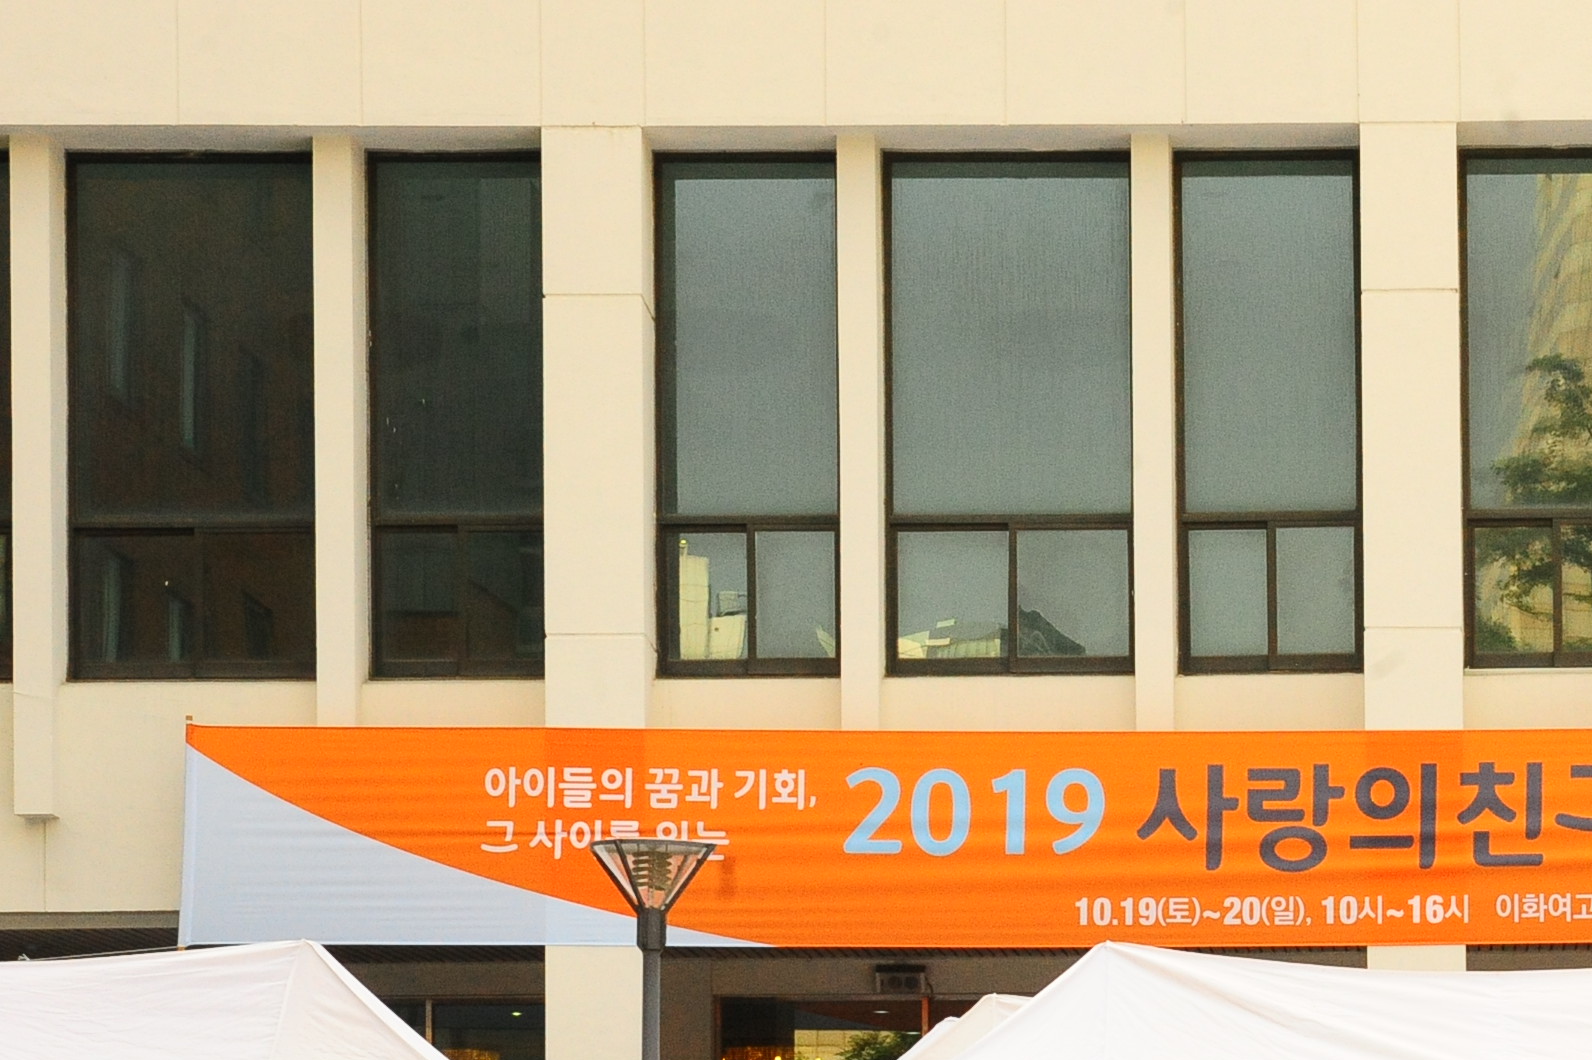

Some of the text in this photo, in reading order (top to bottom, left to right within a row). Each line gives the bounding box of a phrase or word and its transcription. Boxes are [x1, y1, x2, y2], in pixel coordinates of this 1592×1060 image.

[484, 766, 817, 811] 아이들의 꿈과 기회,
[842, 766, 1107, 858] 2019
[480, 820, 519, 854] 그
[1075, 895, 1312, 927] 10.19(토)~20(일),
[1321, 894, 1470, 925] 10시~16시
